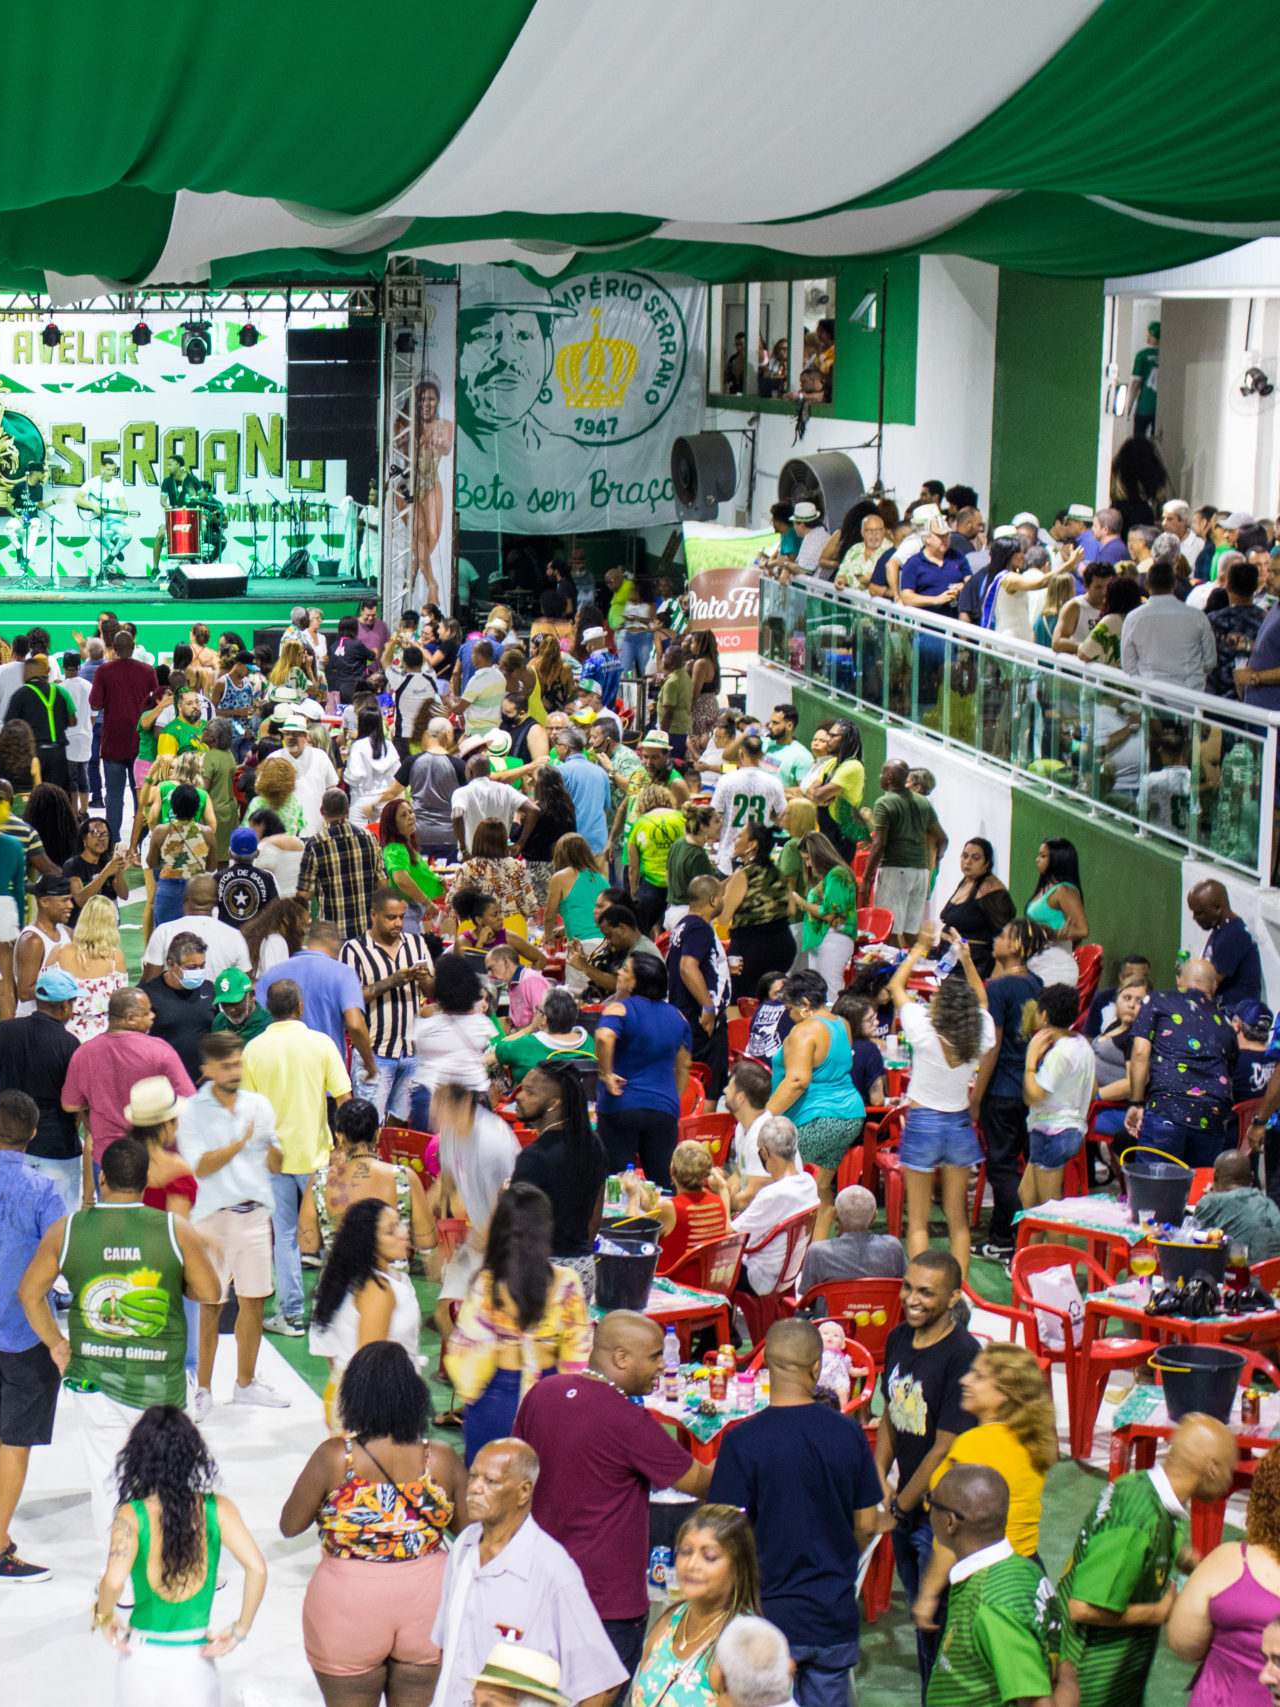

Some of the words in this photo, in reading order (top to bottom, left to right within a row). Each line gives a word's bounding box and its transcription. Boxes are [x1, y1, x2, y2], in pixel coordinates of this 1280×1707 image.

[12, 330, 138, 364] AVELAR
[554, 276, 643, 308] MPÉRIO
[644, 295, 676, 405] SERRANO
[574, 416, 619, 437] 1947
[455, 473, 518, 511] Beto
[528, 487, 575, 513] sem
[590, 469, 674, 513] Braço
[731, 793, 766, 828] 23
[102, 1247, 140, 1262] CAIXA
[80, 1342, 122, 1359] Mestre
[123, 1346, 166, 1361] Gilmar
